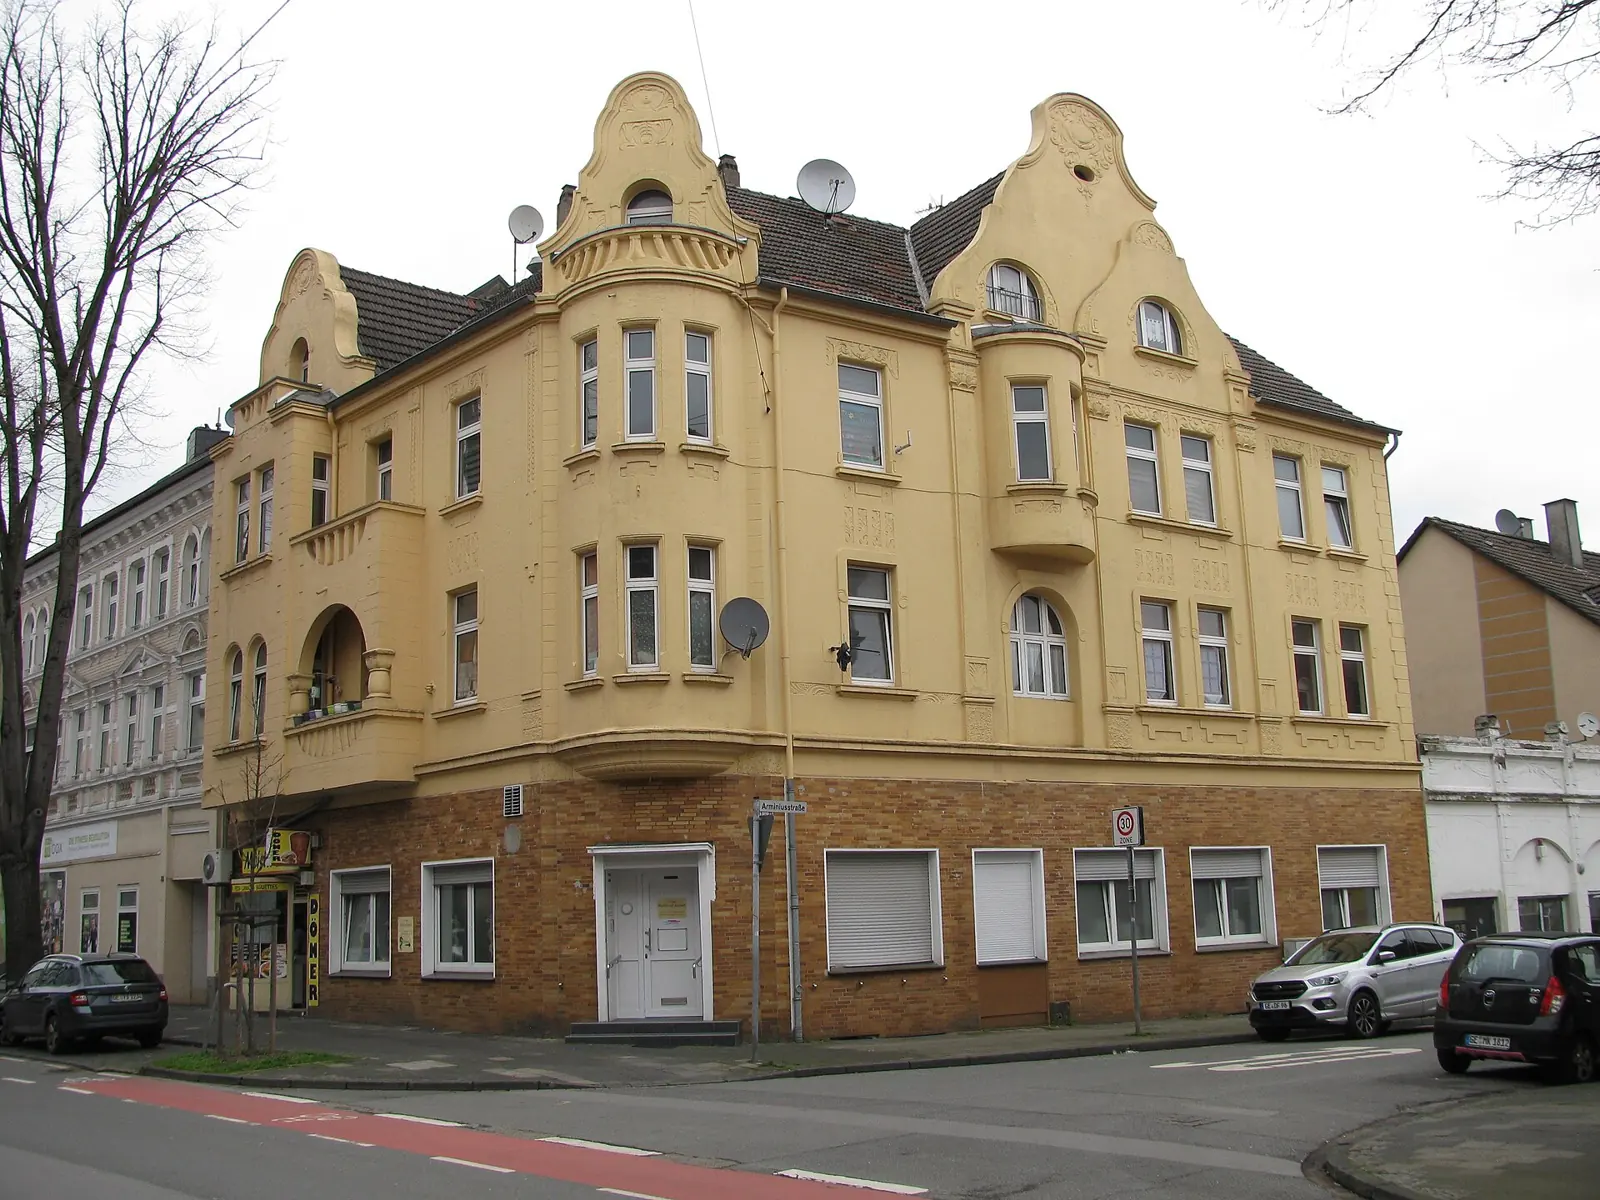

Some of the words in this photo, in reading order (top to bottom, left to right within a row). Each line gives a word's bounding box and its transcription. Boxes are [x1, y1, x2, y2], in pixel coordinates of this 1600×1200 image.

[762, 803, 805, 811] Arminiusstraße
[1121, 818, 1131, 829] 30
[309, 898, 319, 1000] DÖNER
